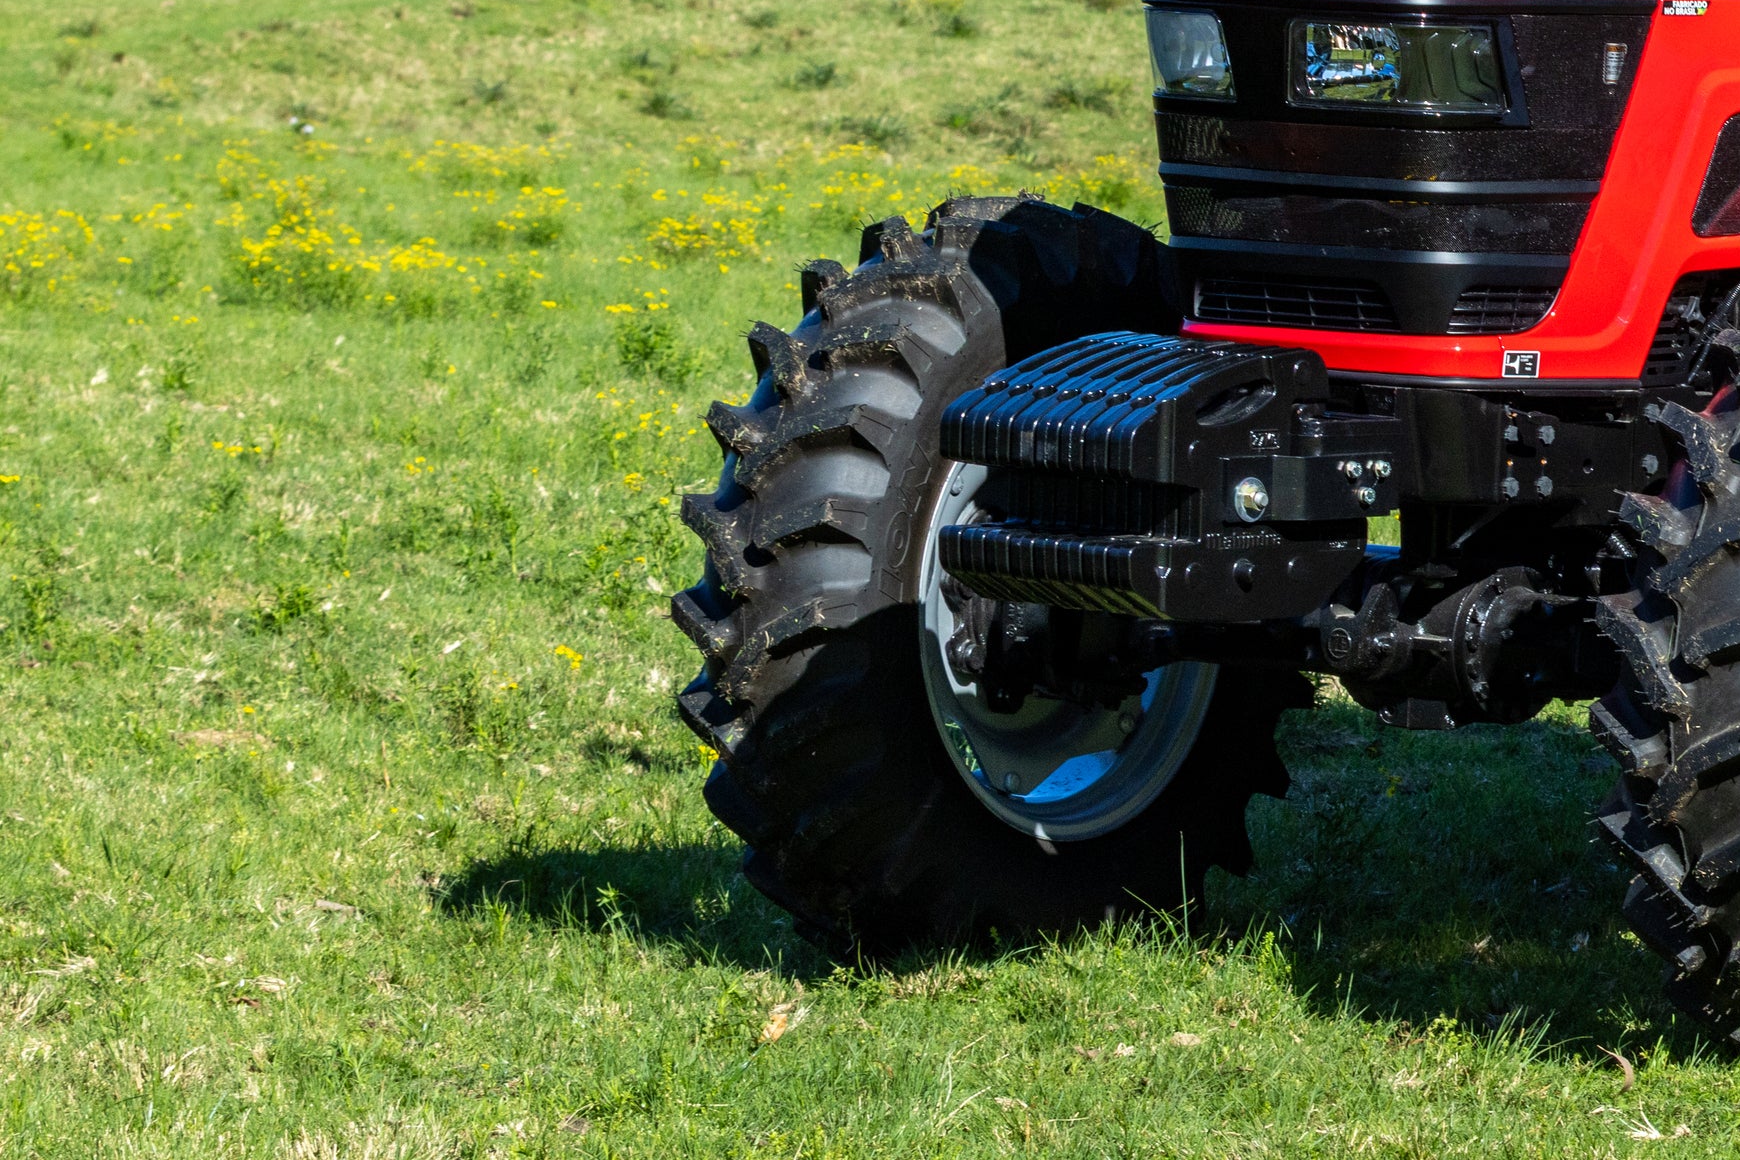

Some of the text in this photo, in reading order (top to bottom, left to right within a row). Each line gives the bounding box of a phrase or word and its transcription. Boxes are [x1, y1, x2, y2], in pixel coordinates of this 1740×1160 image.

[1672, 0, 1708, 8] FABRICADO
[1663, 7, 1697, 15] NO BRASIL
